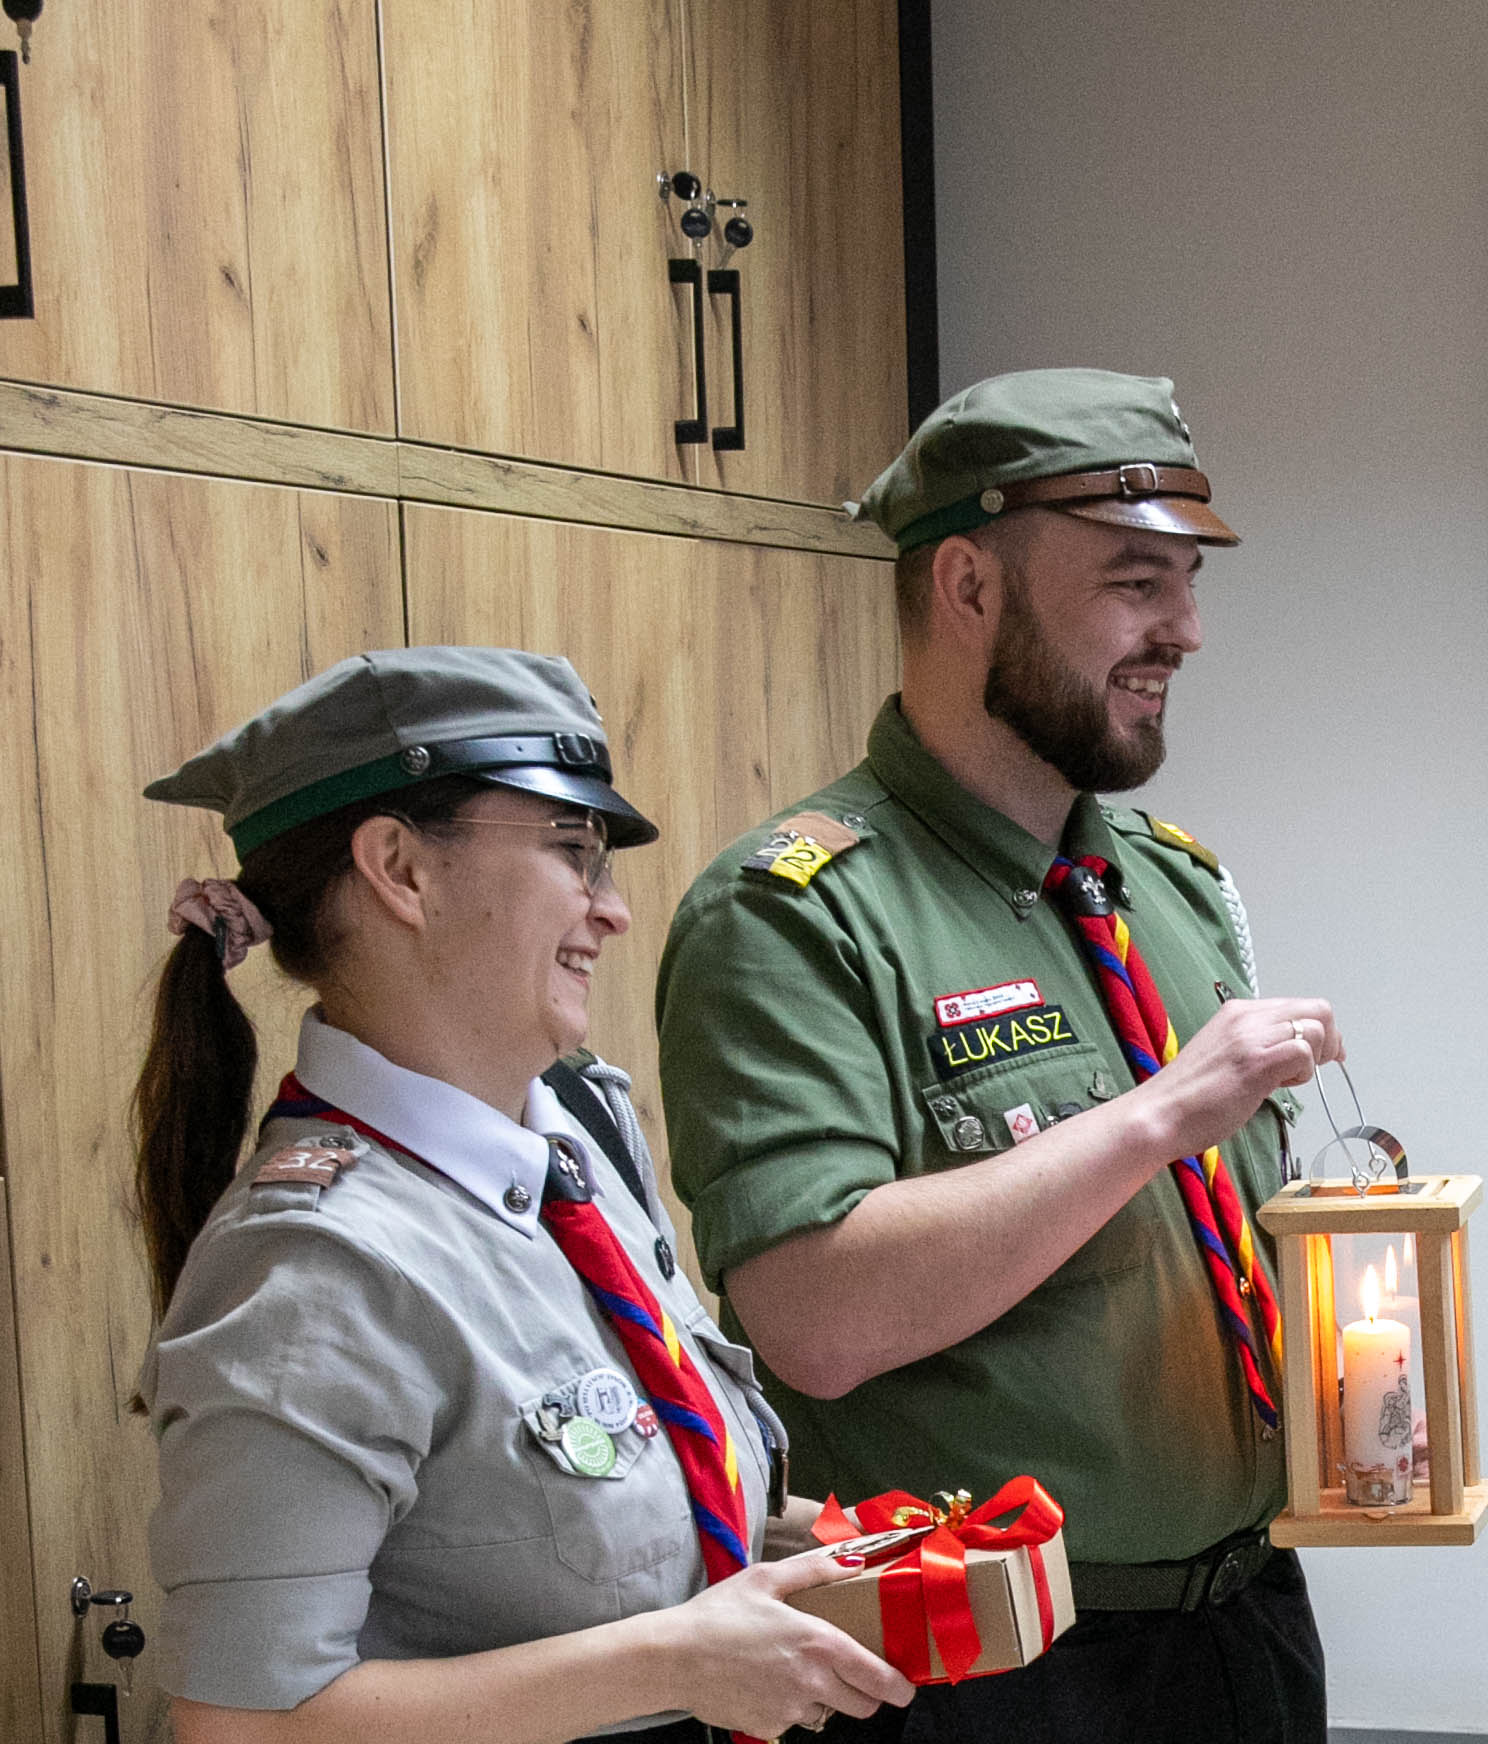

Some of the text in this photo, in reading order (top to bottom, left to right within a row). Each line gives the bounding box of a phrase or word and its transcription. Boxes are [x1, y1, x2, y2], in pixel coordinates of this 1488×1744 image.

[781, 849, 816, 869] 2
[942, 1011, 1072, 1067] ŁUKASZ
[278, 1151, 338, 1172] 32
